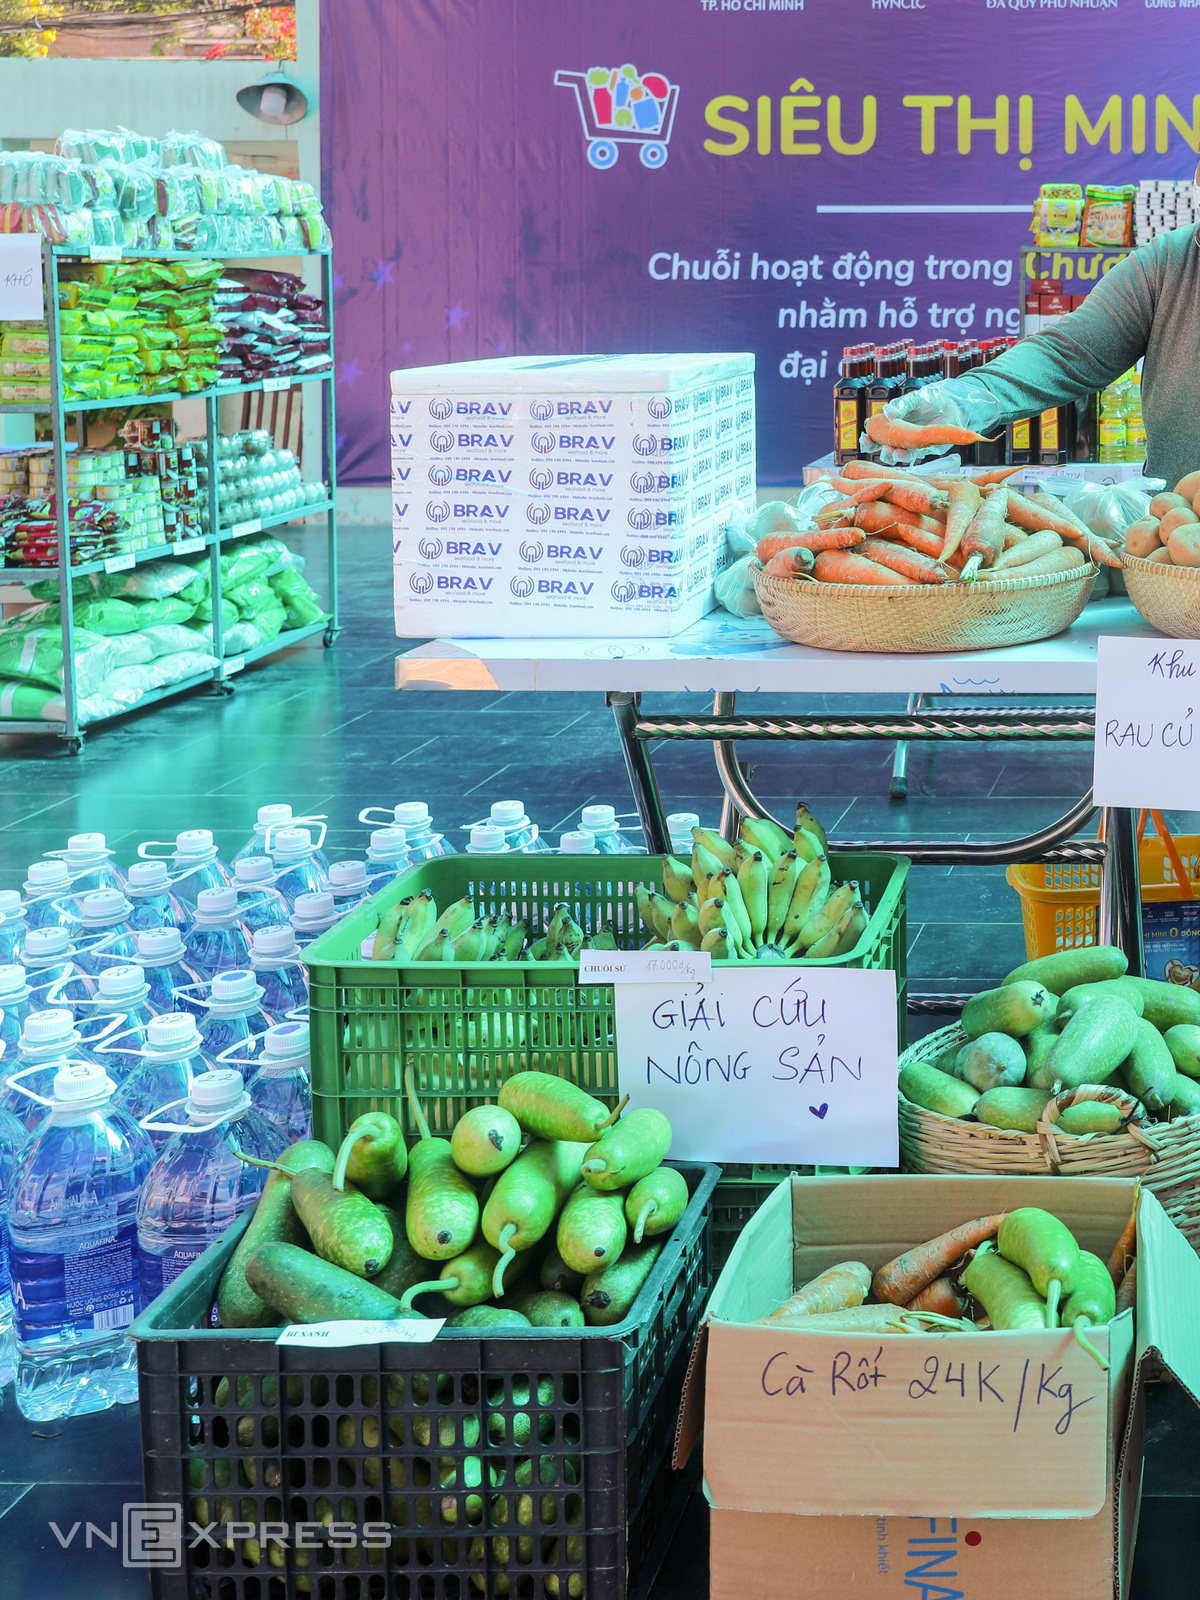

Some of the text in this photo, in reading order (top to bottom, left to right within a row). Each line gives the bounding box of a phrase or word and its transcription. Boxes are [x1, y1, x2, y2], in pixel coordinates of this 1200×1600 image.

[703, 78, 877, 156] SIÊU
[902, 94, 1033, 171] THỊ
[647, 249, 741, 281] Chuỗi
[750, 253, 824, 288] hoạt
[832, 252, 915, 287] động
[925, 256, 1014, 286] trong
[778, 297, 867, 329] nhằm
[878, 296, 919, 329] hỗ
[928, 302, 977, 335] trợ
[779, 352, 827, 391] đại
[456, 402, 513, 416] BRAV
[557, 400, 613, 415] BRAV
[458, 434, 514, 448] BRAV
[559, 435, 616, 449] BRAV
[456, 469, 512, 483] BRAV
[557, 472, 613, 486] BRAV
[453, 504, 510, 518] BRAV
[554, 507, 611, 522] BRAV
[446, 541, 502, 556] BRAV
[547, 545, 603, 560] BRAV
[437, 576, 493, 590] BRAV
[538, 580, 594, 595] BRAV
[1147, 650, 1197, 679] Khu
[1105, 719, 1154, 748] RAU
[1161, 707, 1194, 748] CỦ
[1169, 927, 1178, 938] 0
[584, 964, 612, 972] CHUỐI
[615, 964, 627, 972] SỨ
[652, 976, 827, 1031] GIẢI CỨU
[159, 1014, 184, 1024] 22
[647, 1034, 863, 1085] NÔNG SẢN
[199, 1073, 235, 1082] 22
[78, 1235, 118, 1251] AQUAFINA
[173, 1250, 204, 1259] AQUAFI
[761, 1351, 814, 1397] Cà
[831, 1346, 887, 1397] Rốt
[876, 1517, 891, 1575] tinh khiết
